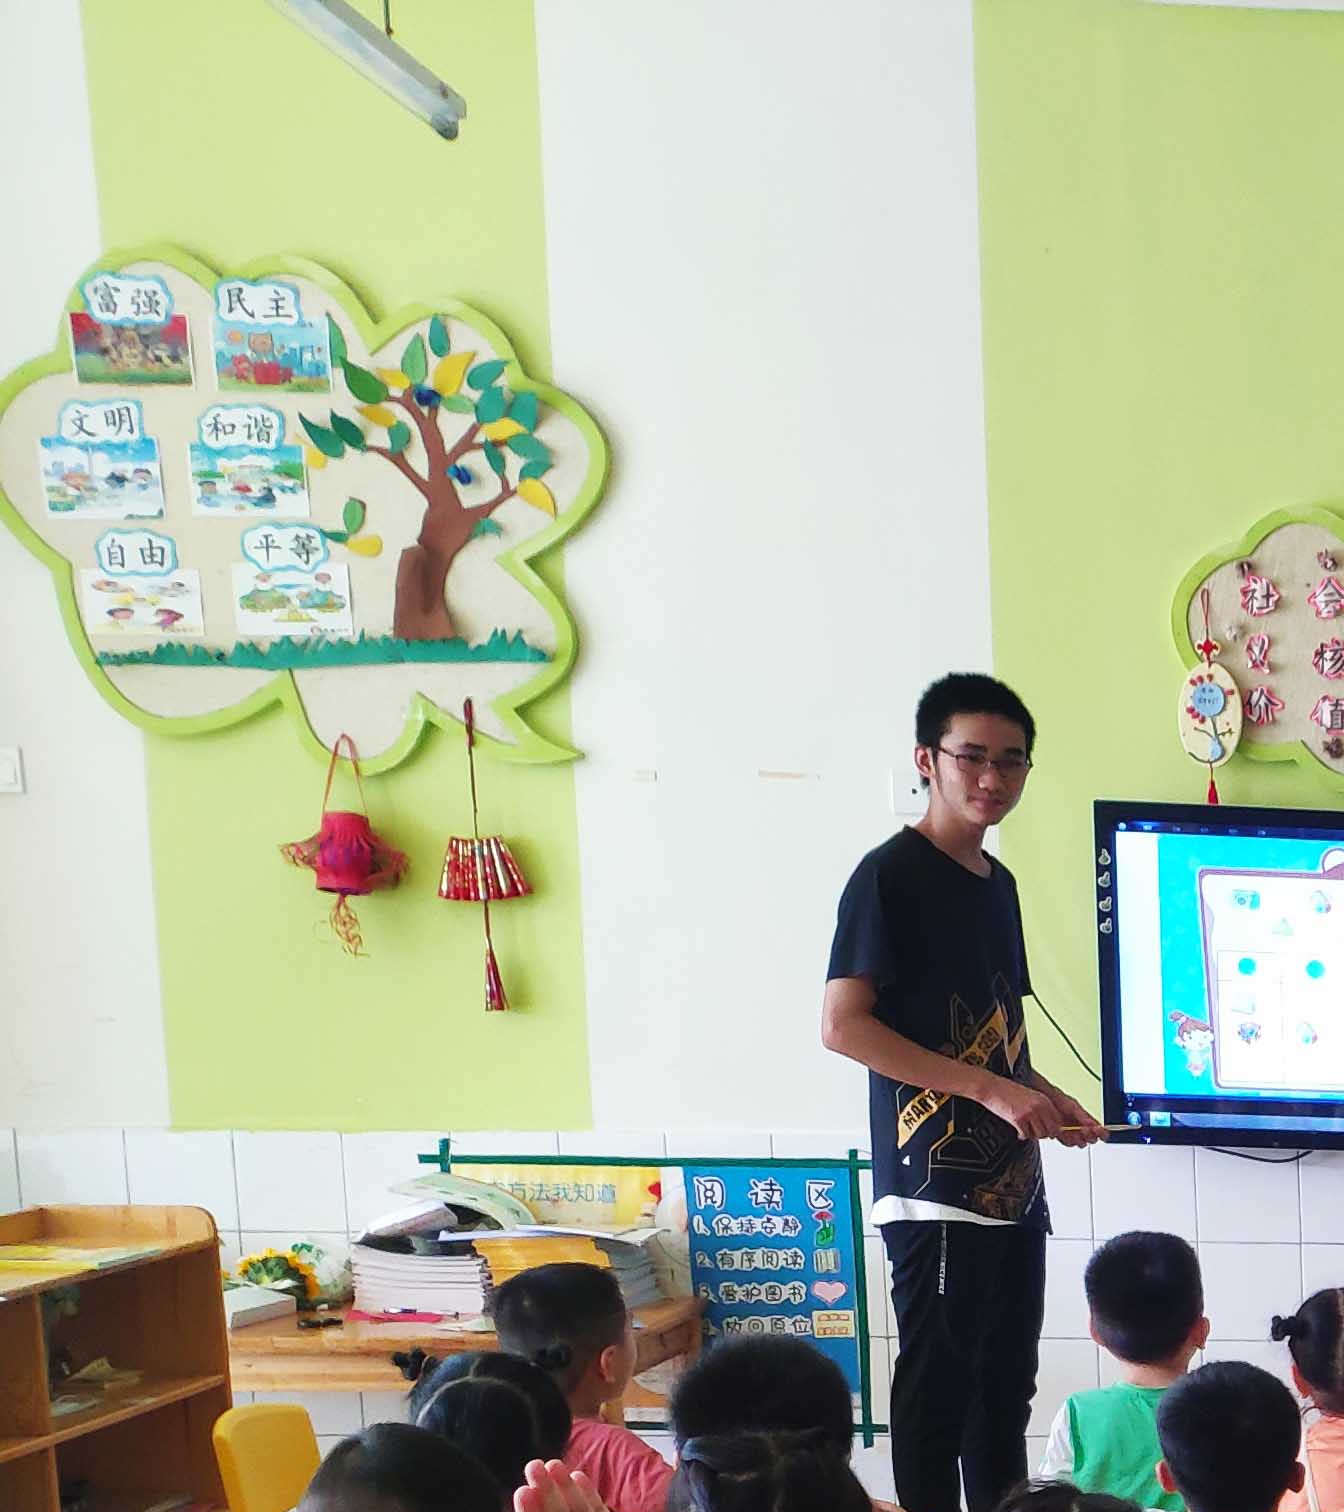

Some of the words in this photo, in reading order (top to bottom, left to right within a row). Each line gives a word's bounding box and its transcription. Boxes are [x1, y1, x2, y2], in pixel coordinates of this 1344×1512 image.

[93, 284, 165, 319] 富强
[226, 287, 295, 319] 民主
[69, 405, 137, 436] 文明
[206, 412, 275, 445] 和谐
[105, 536, 166, 569] 自由
[254, 531, 323, 560] 平等
[494, 1180, 617, 1204] 方法我知道
[694, 1176, 835, 1211] 阅读区
